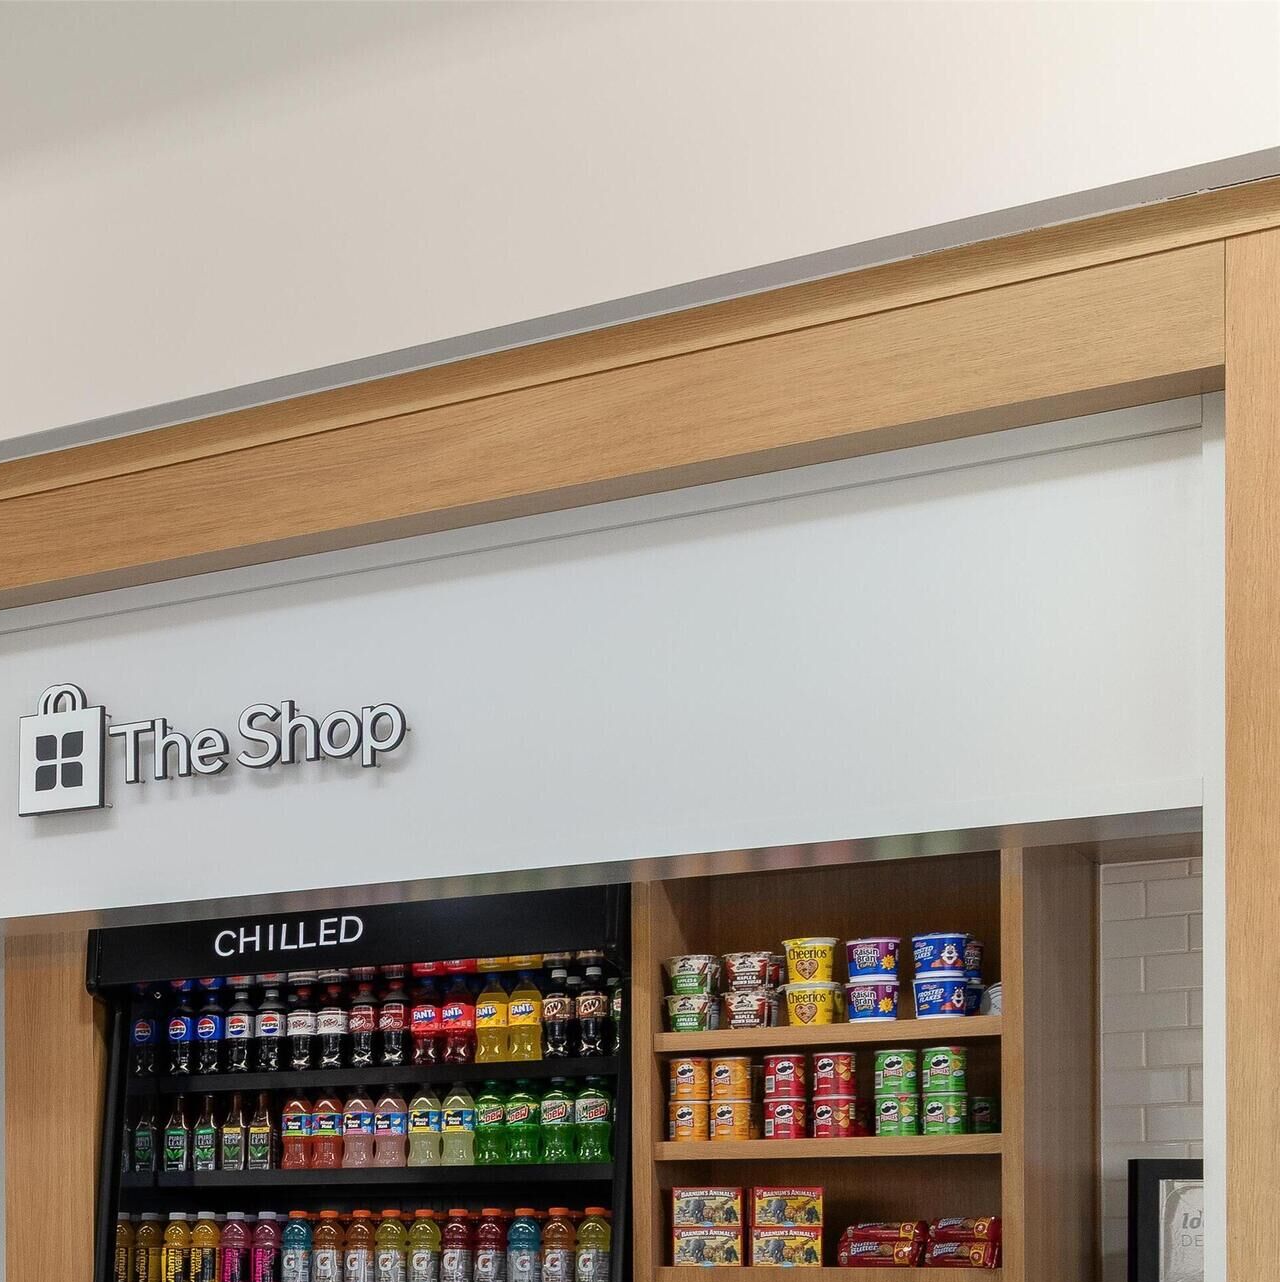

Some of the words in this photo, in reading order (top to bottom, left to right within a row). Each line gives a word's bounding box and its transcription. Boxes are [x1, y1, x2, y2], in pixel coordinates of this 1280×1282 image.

[109, 716, 229, 784] The
[237, 700, 407, 768] Shop
[214, 915, 364, 958] CHILLED
[788, 949, 827, 960] Cheerios
[858, 955, 876, 963] Bran
[788, 993, 826, 1004] Cheerios
[852, 991, 876, 999] Raisin
[918, 988, 944, 998] FROSTED
[919, 995, 941, 1003] FLAKES
[442, 1008, 462, 1019] FANTA
[477, 1006, 497, 1017] FANTA
[512, 1003, 533, 1014] FANTA
[413, 1009, 435, 1020] FANTA
[851, 1245, 879, 1255] Butter
[933, 1246, 957, 1256] Butter
